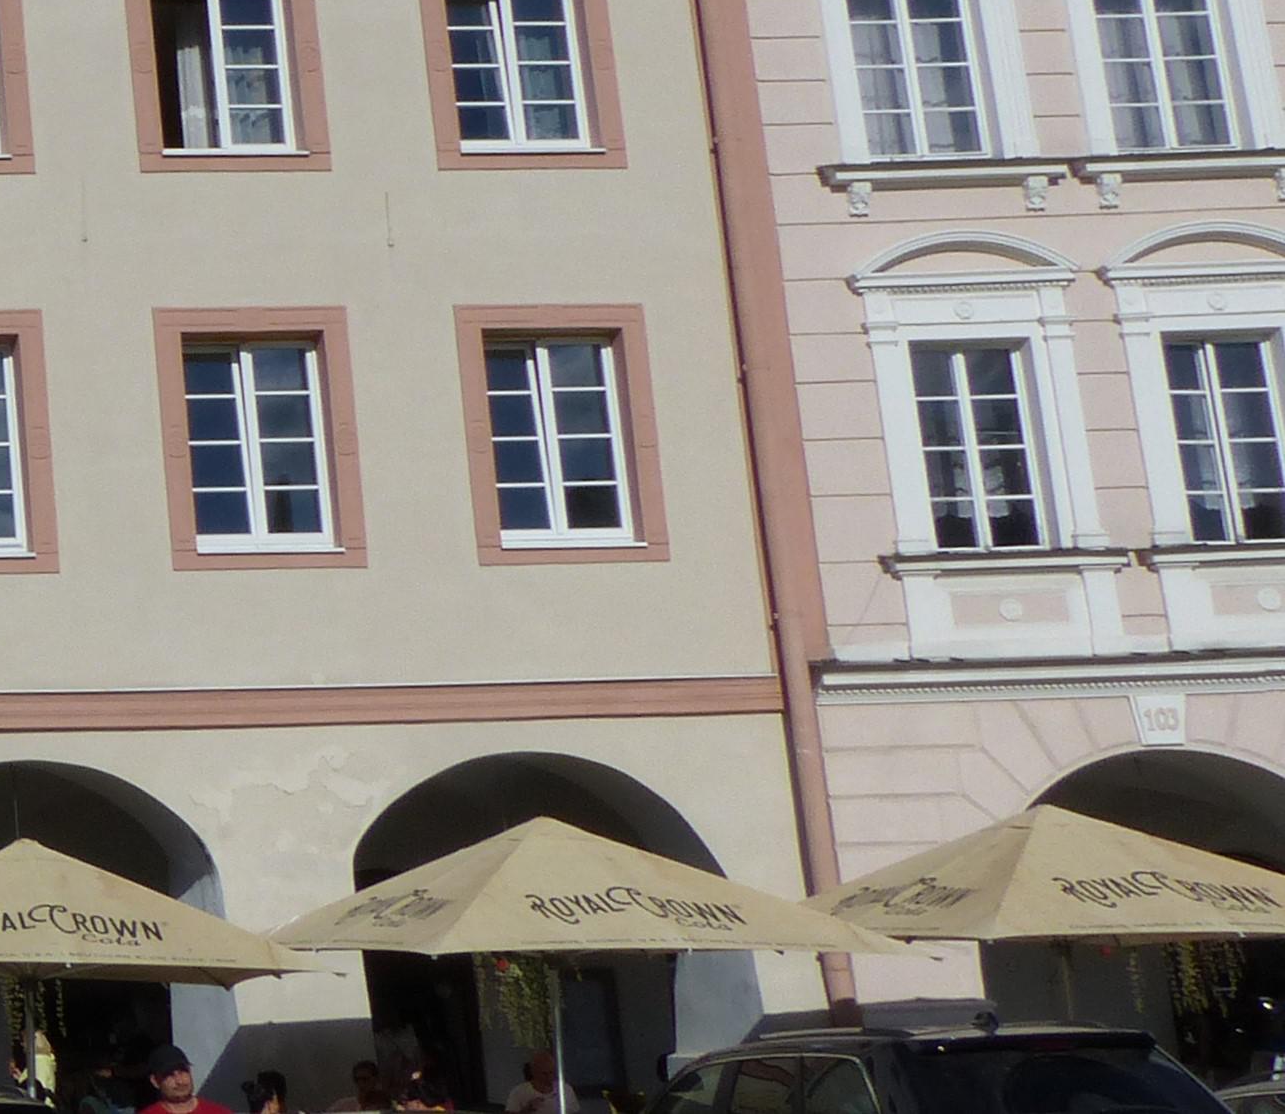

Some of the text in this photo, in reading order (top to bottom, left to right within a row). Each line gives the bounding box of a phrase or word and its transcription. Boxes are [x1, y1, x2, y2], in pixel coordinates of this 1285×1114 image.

[28, 903, 164, 941] CROWN
[526, 886, 747, 925] ROYAL CROWN
